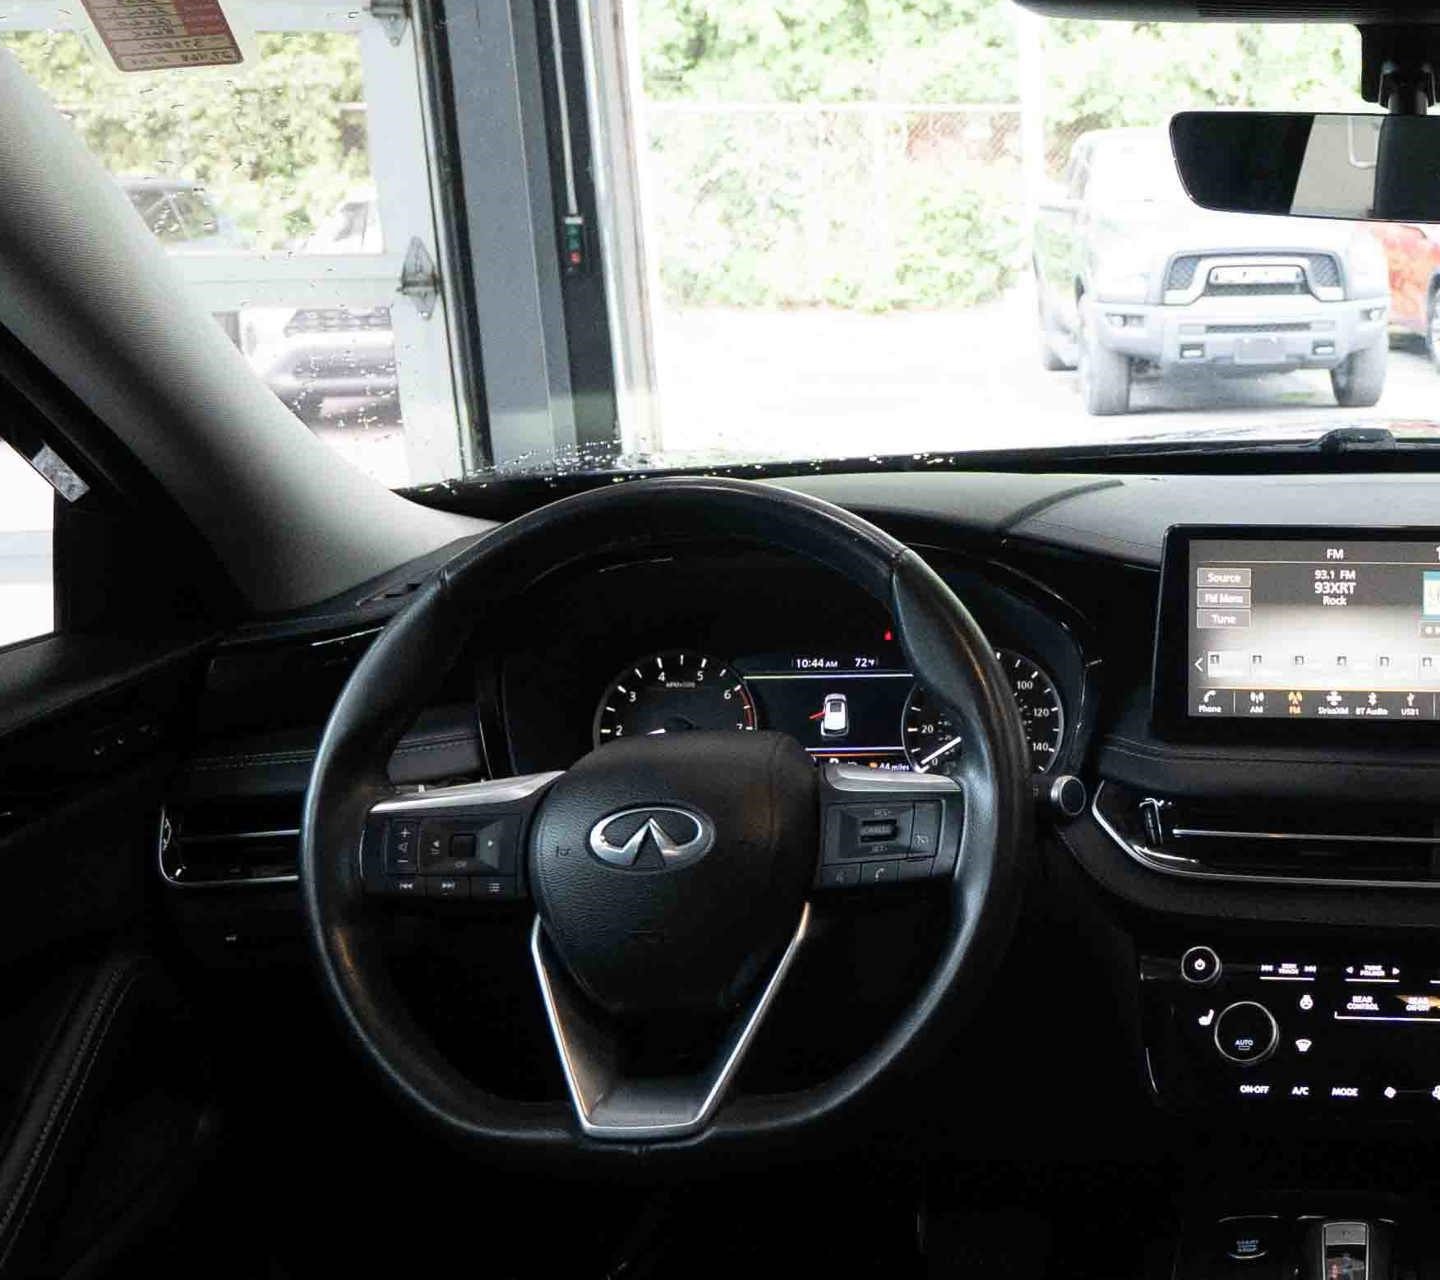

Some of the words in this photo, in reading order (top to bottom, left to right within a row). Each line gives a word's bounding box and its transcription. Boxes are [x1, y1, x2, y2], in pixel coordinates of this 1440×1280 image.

[1326, 548, 1344, 559] FM
[1206, 572, 1242, 584] Source
[1314, 569, 1335, 580] 93.1
[1339, 570, 1356, 580] FM
[1314, 582, 1357, 595] 93XRT
[1322, 595, 1347, 607] Rock
[1211, 614, 1236, 625] Tune
[796, 658, 824, 669] 10:44
[657, 672, 666, 682] 4
[697, 671, 704, 681] 5
[1016, 680, 1034, 690] 100
[629, 691, 637, 702] 3
[724, 689, 732, 700] 6
[1033, 707, 1050, 718] 120
[1198, 705, 1222, 713] Phone
[616, 726, 624, 736] 2
[921, 724, 934, 734] 20
[1032, 742, 1049, 752] 140
[1352, 996, 1373, 1004] REAR
[1346, 1003, 1379, 1012] CONTROL
[1235, 1039, 1254, 1047] AUTO
[1291, 1086, 1309, 1096] A/C
[1331, 1087, 1359, 1097] MODE
